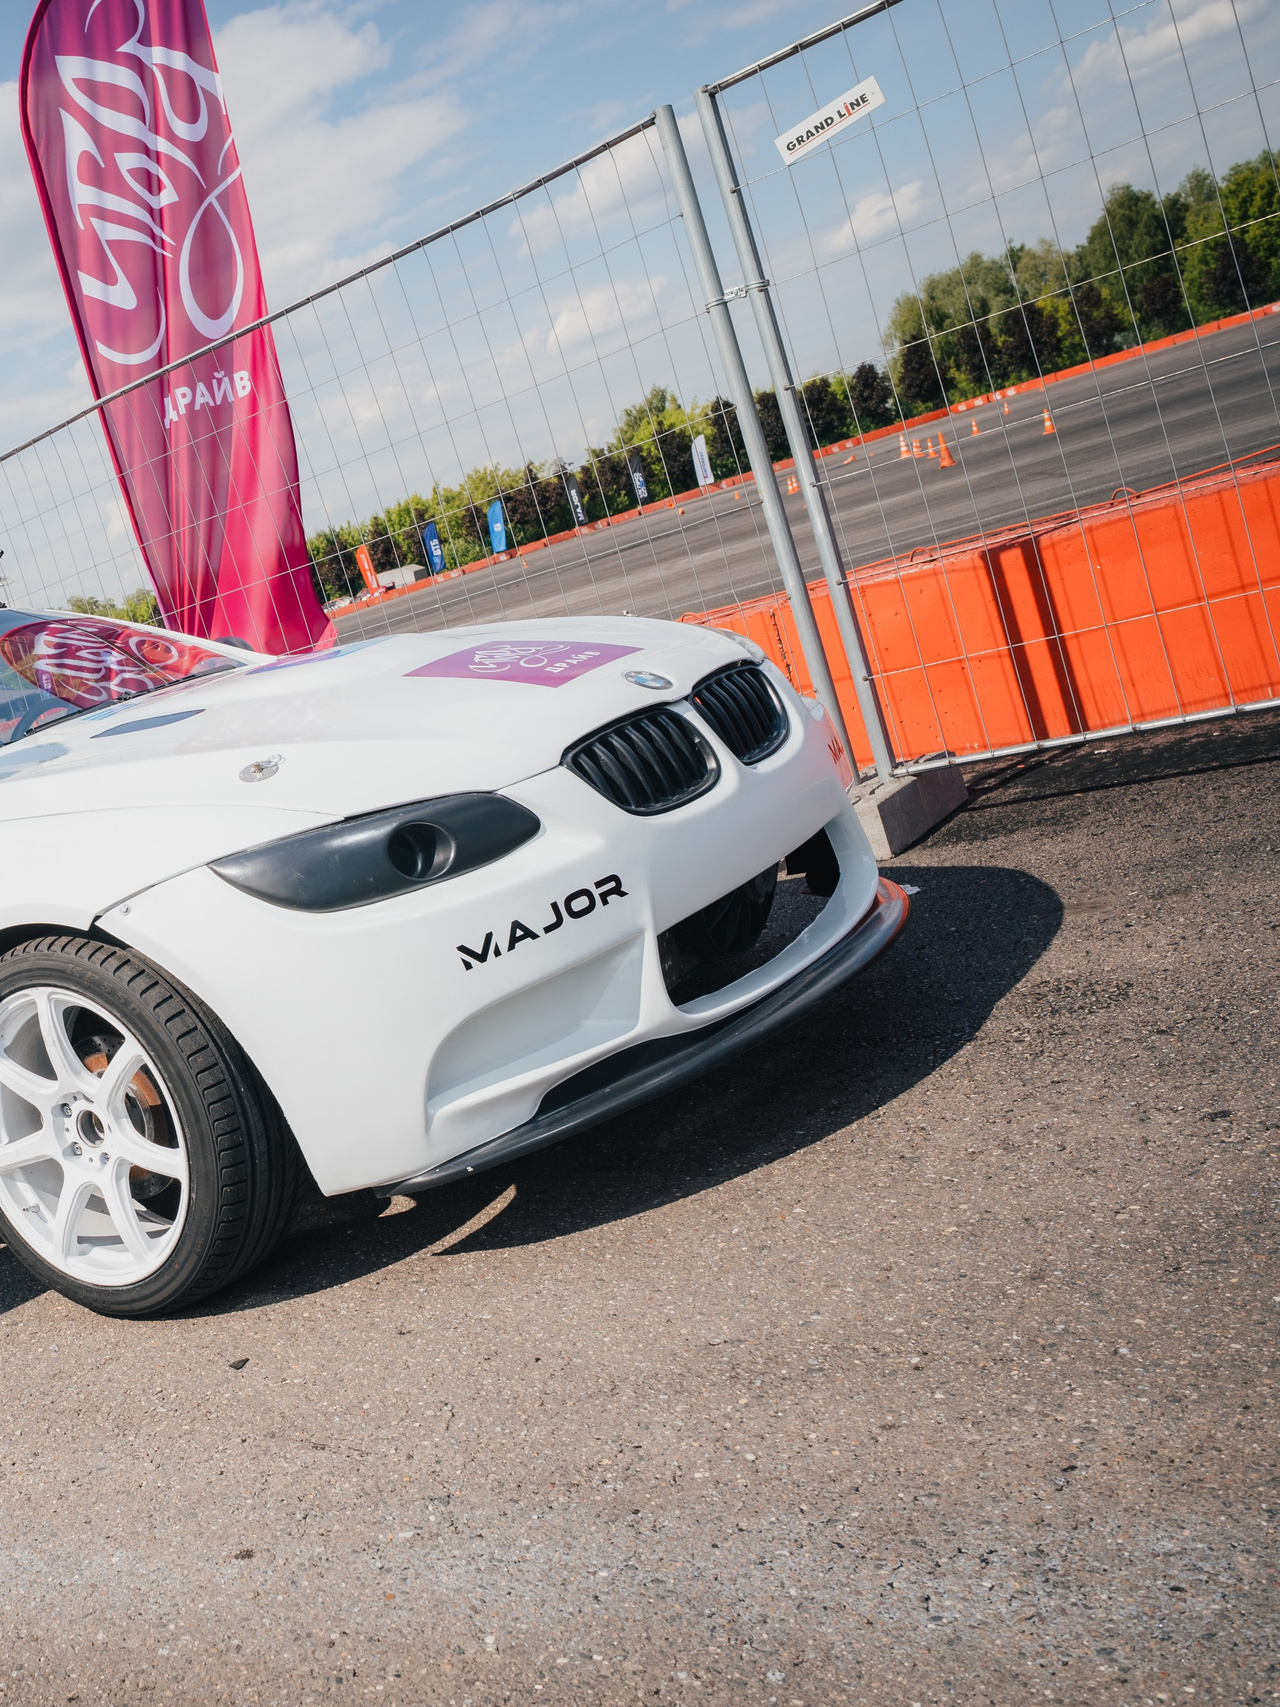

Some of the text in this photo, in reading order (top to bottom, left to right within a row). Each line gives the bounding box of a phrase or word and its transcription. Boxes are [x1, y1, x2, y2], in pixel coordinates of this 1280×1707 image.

[786, 93, 869, 152] GRAND LINE
[163, 370, 252, 429] ДРАЙВ
[570, 488, 585, 521] MAJOR
[429, 538, 442, 556] ВТБ
[544, 651, 601, 674] ДРАЙВ
[455, 873, 629, 972] MAJOR
